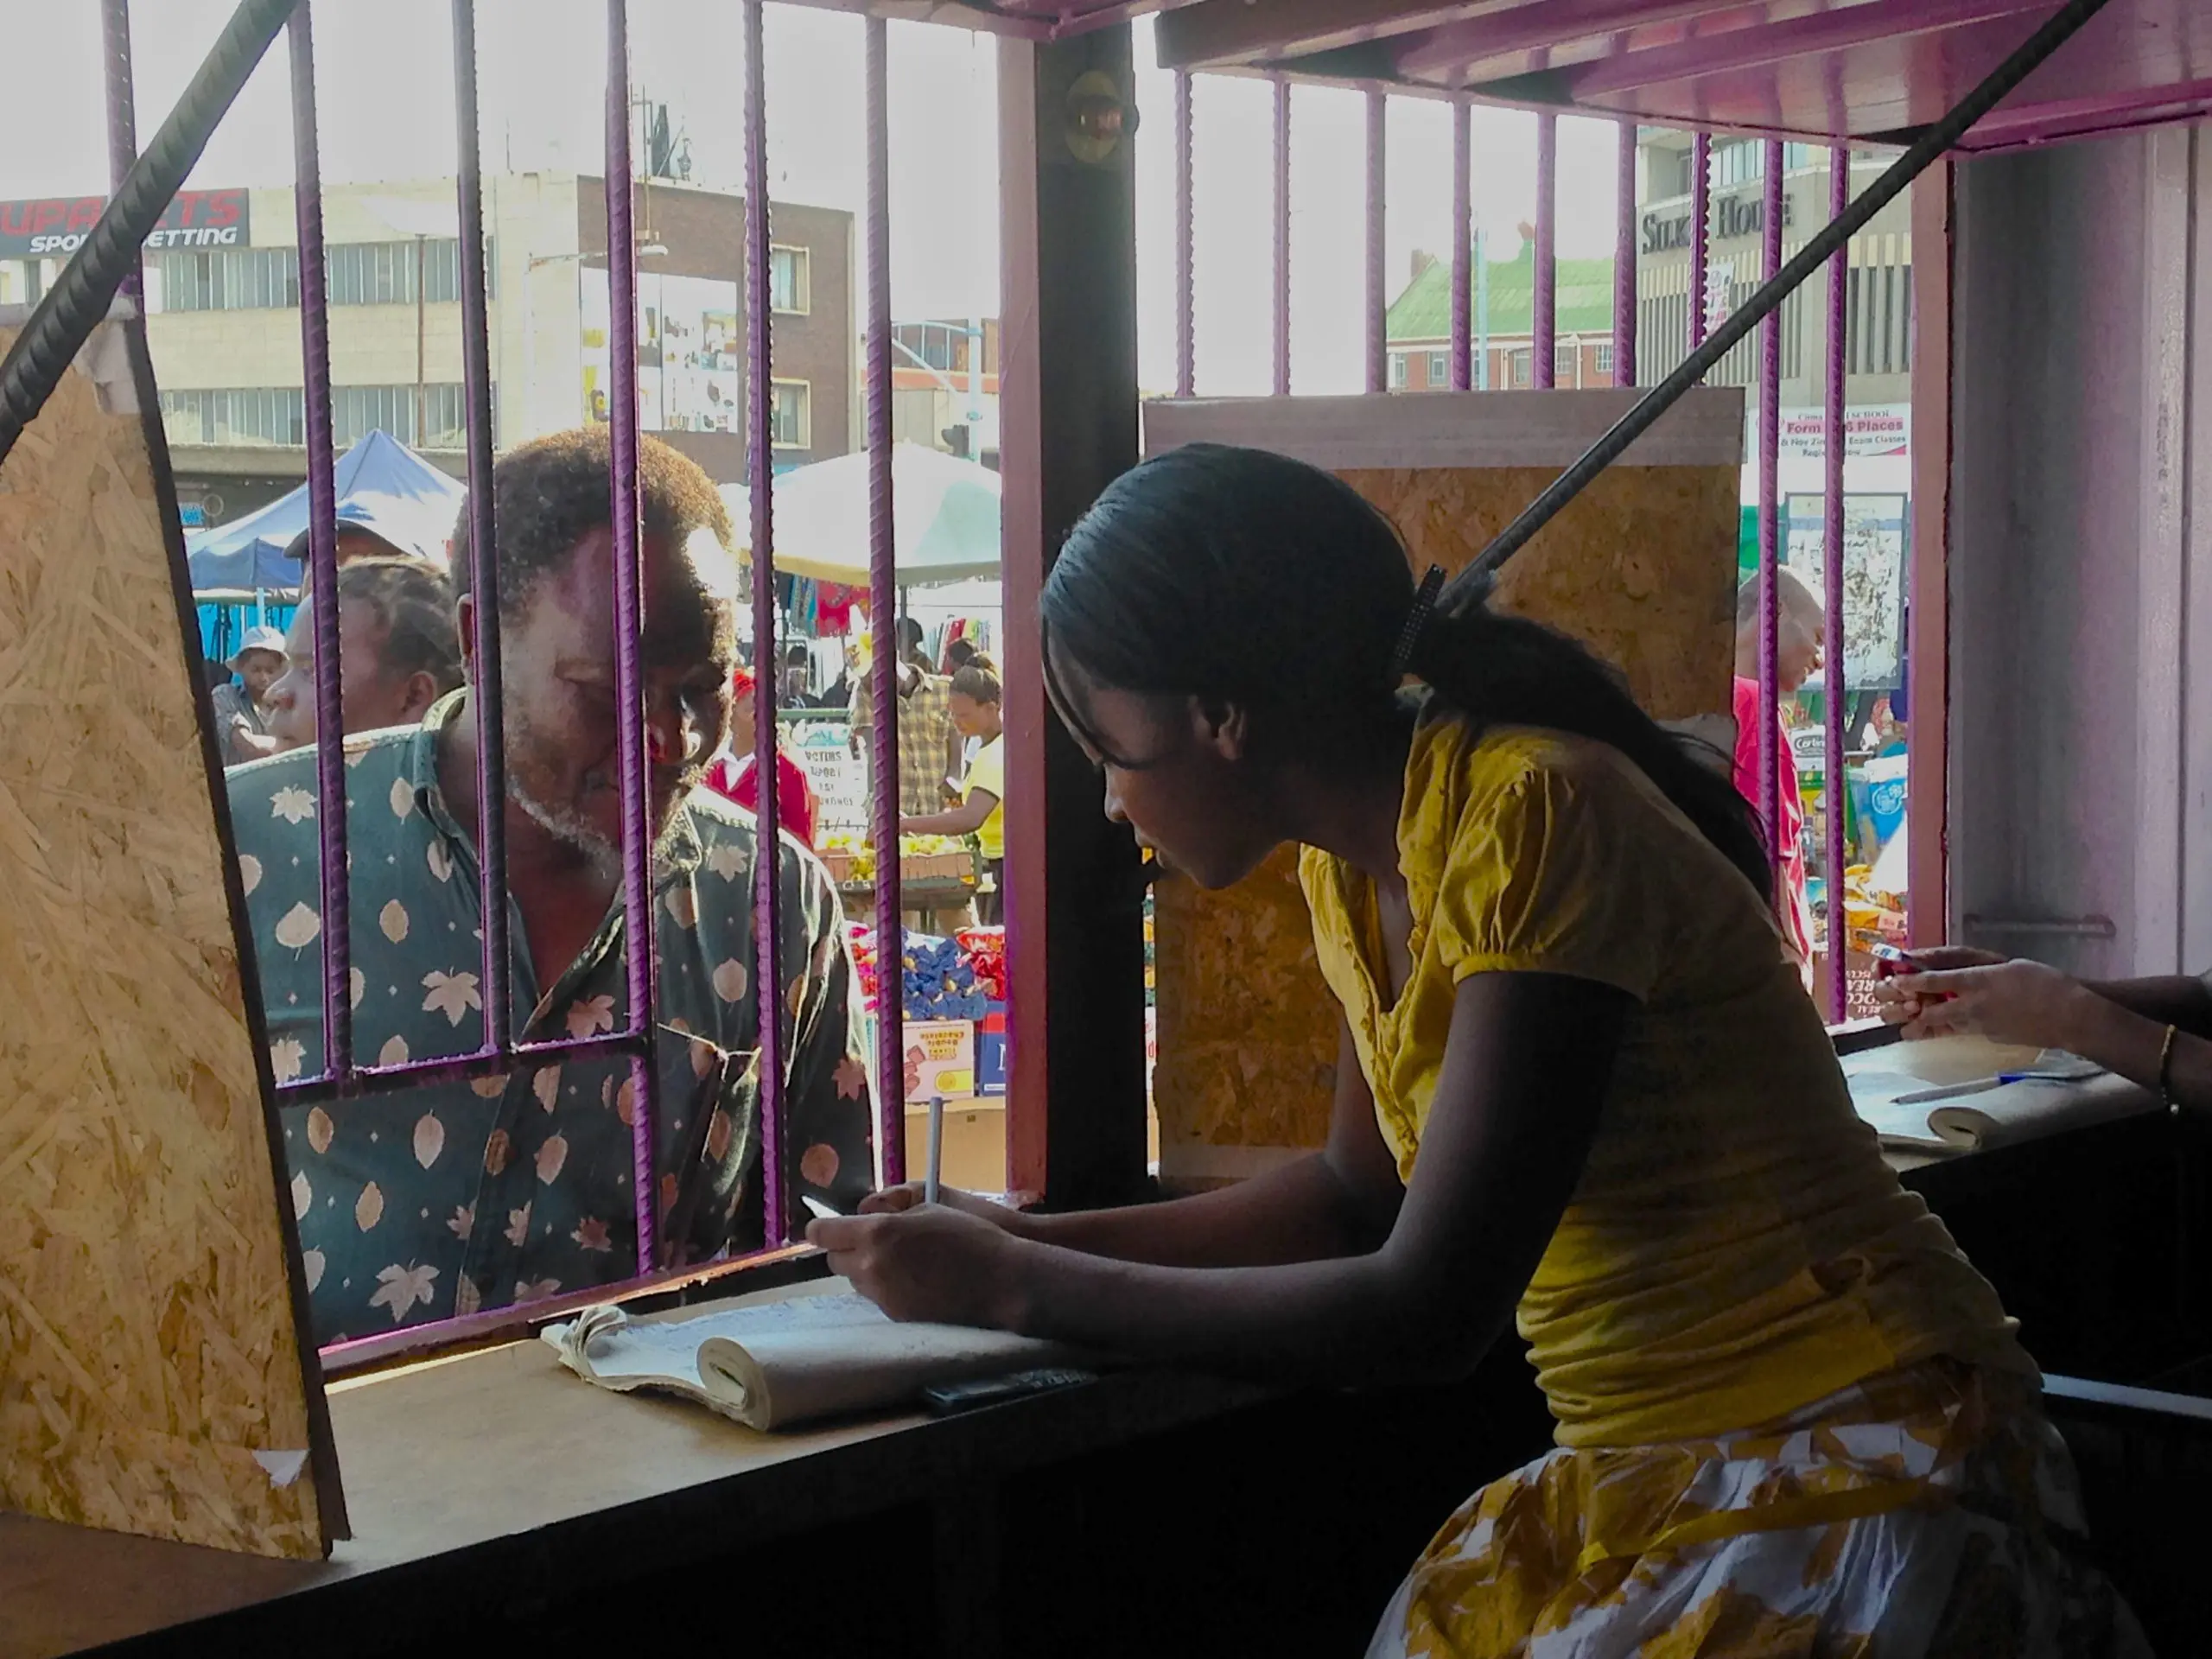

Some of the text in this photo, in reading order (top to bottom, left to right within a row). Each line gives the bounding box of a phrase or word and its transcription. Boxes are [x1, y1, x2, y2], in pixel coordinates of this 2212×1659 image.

[141, 226, 238, 248] ETTING
[1787, 422, 1821, 435] Form
[1858, 420, 1904, 432] Places
[1875, 435, 1906, 444] Classes
